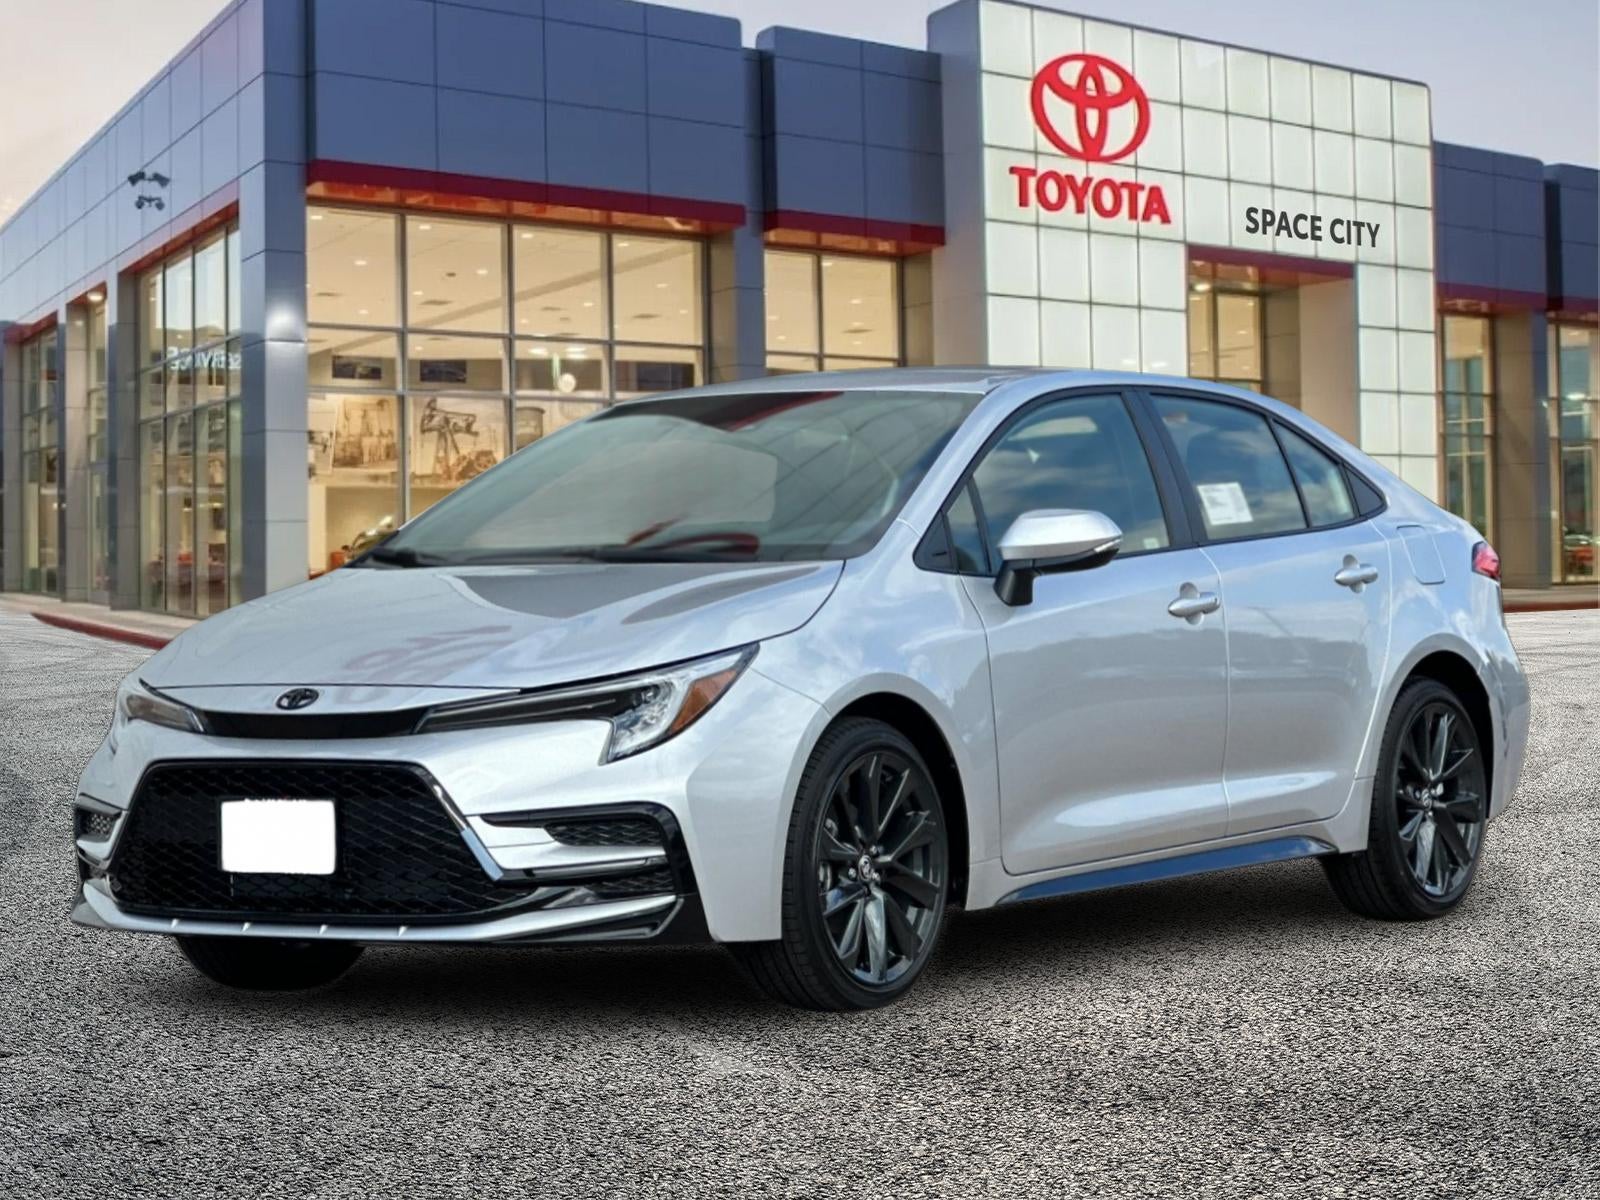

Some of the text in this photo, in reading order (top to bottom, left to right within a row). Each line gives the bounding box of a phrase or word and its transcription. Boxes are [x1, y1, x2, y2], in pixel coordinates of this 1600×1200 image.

[1009, 166, 1171, 224] TOYOTA
[1245, 207, 1380, 248] SPACE CITY
